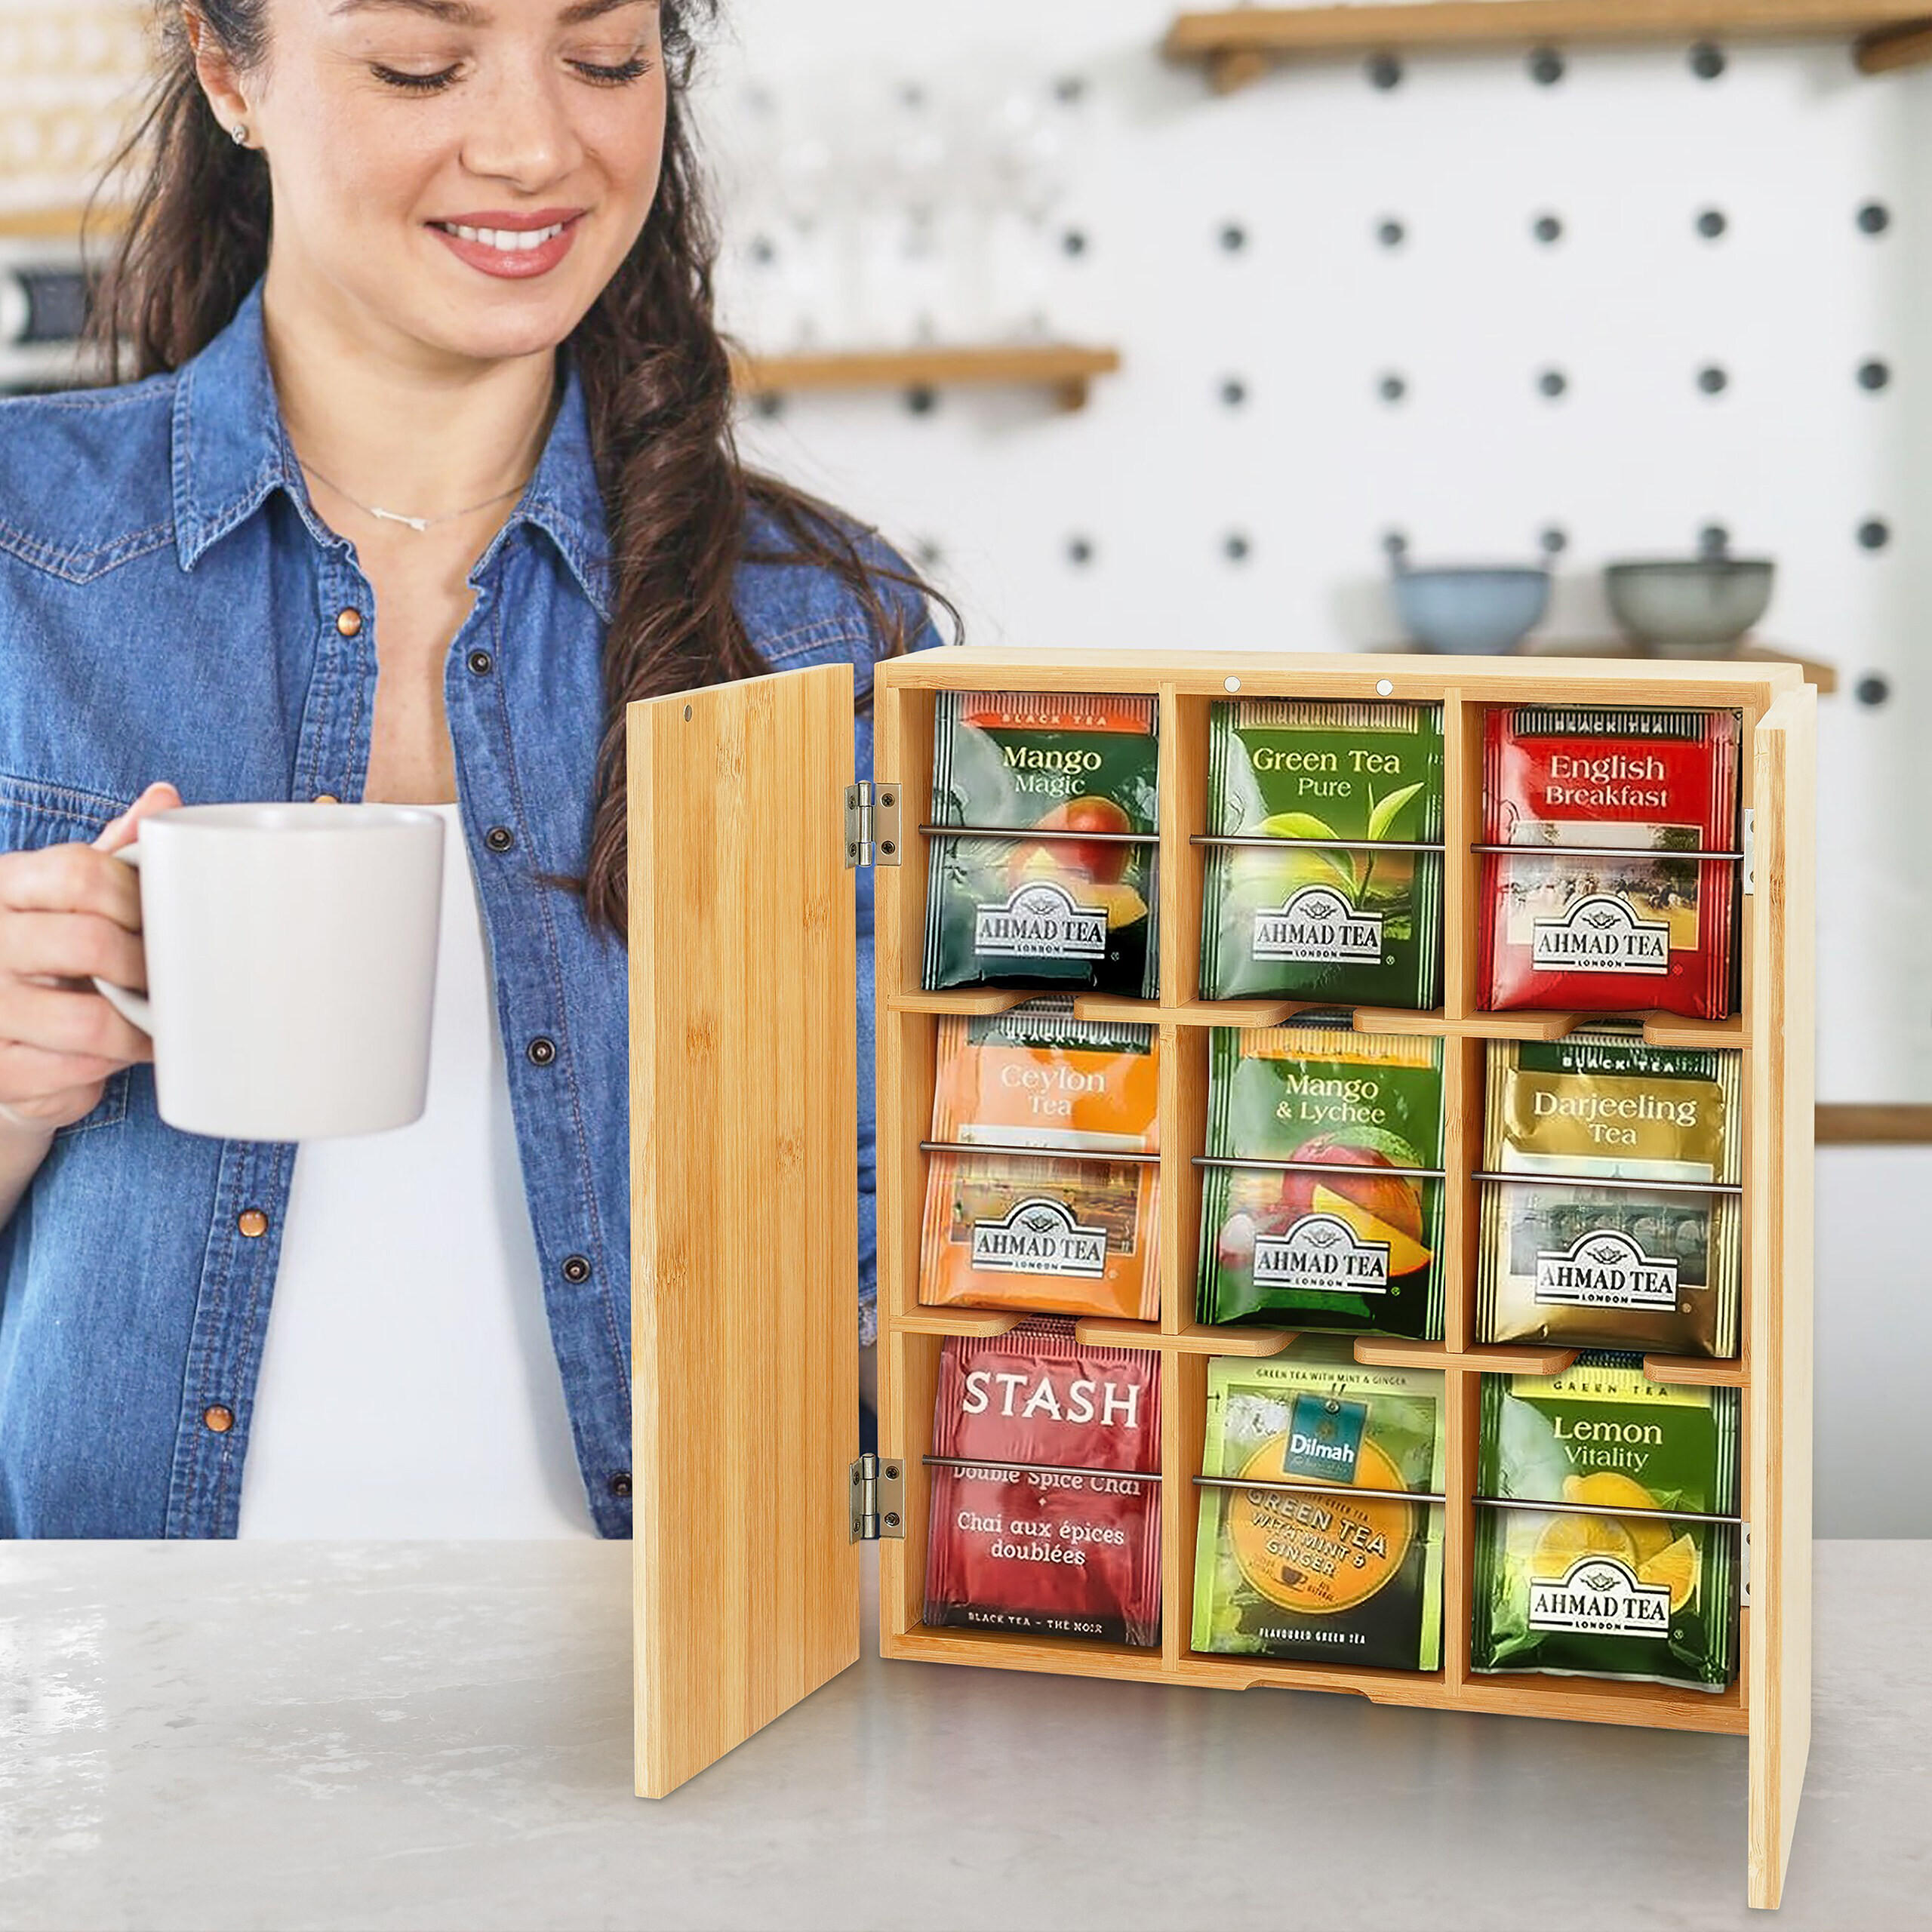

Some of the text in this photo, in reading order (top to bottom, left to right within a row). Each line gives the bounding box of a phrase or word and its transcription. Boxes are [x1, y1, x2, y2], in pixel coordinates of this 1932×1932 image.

[1002, 714, 1107, 725] BLACK TEA
[1003, 746, 1102, 774] Mango
[1253, 748, 1401, 774] Green Tea
[1550, 755, 1665, 783] English
[1015, 774, 1086, 798] Magic
[1297, 777, 1352, 798] Pure
[1545, 785, 1669, 808] Breakfast
[981, 917, 1103, 943] AHMAD TEA
[1257, 923, 1379, 948] AHMAD TEA
[1295, 949, 1338, 958] LONDON
[1538, 933, 1664, 957] AHMAD TEA
[1578, 959, 1623, 968] LONDON
[1001, 1064, 1105, 1093] Ceylon
[1638, 1061, 1675, 1072] TEA
[1285, 1074, 1379, 1103] Mango
[1029, 1095, 1073, 1115] Tea
[1275, 1101, 1386, 1124] & Lychee
[1534, 1091, 1697, 1127] Darjeeling
[1588, 1124, 1638, 1145] Tea
[977, 1233, 1101, 1262] AHMAD TEA
[1257, 1251, 1385, 1278] AHMAD TEA
[1295, 1278, 1343, 1287] LONDON
[1540, 1267, 1673, 1294] AHMAD TEA
[1582, 1294, 1629, 1303] LONDON
[1256, 1368, 1287, 1379] GREEN
[1290, 1370, 1306, 1380] TEA
[1309, 1371, 1334, 1382] WITH
[1337, 1373, 1359, 1383] MINT
[1373, 1376, 1406, 1386] GINGER
[1554, 1381, 1669, 1397] GREEN TEA
[962, 1371, 1141, 1428] STASH
[1553, 1417, 1663, 1444] Lemon
[1291, 1433, 1355, 1463] Dilmah
[1564, 1445, 1649, 1473] Vitality
[1028, 1472, 1083, 1491] Spice
[1090, 1478, 1142, 1496] Chai
[958, 1512, 1125, 1546] Chai aux épices
[1247, 1489, 1386, 1558] GREEN TEA
[991, 1539, 1086, 1565] doublées
[1266, 1539, 1337, 1577] GINGER
[1302, 1533, 1350, 1560] MINT
[1534, 1594, 1666, 1621] AHMAD TEA
[968, 1611, 1004, 1623] BLACK
[1008, 1616, 1031, 1626] TEA
[1073, 1622, 1103, 1634] NOIR
[1575, 1621, 1622, 1630] LONDON
[1260, 1627, 1365, 1644] FLAVOURED GREEN TEA
